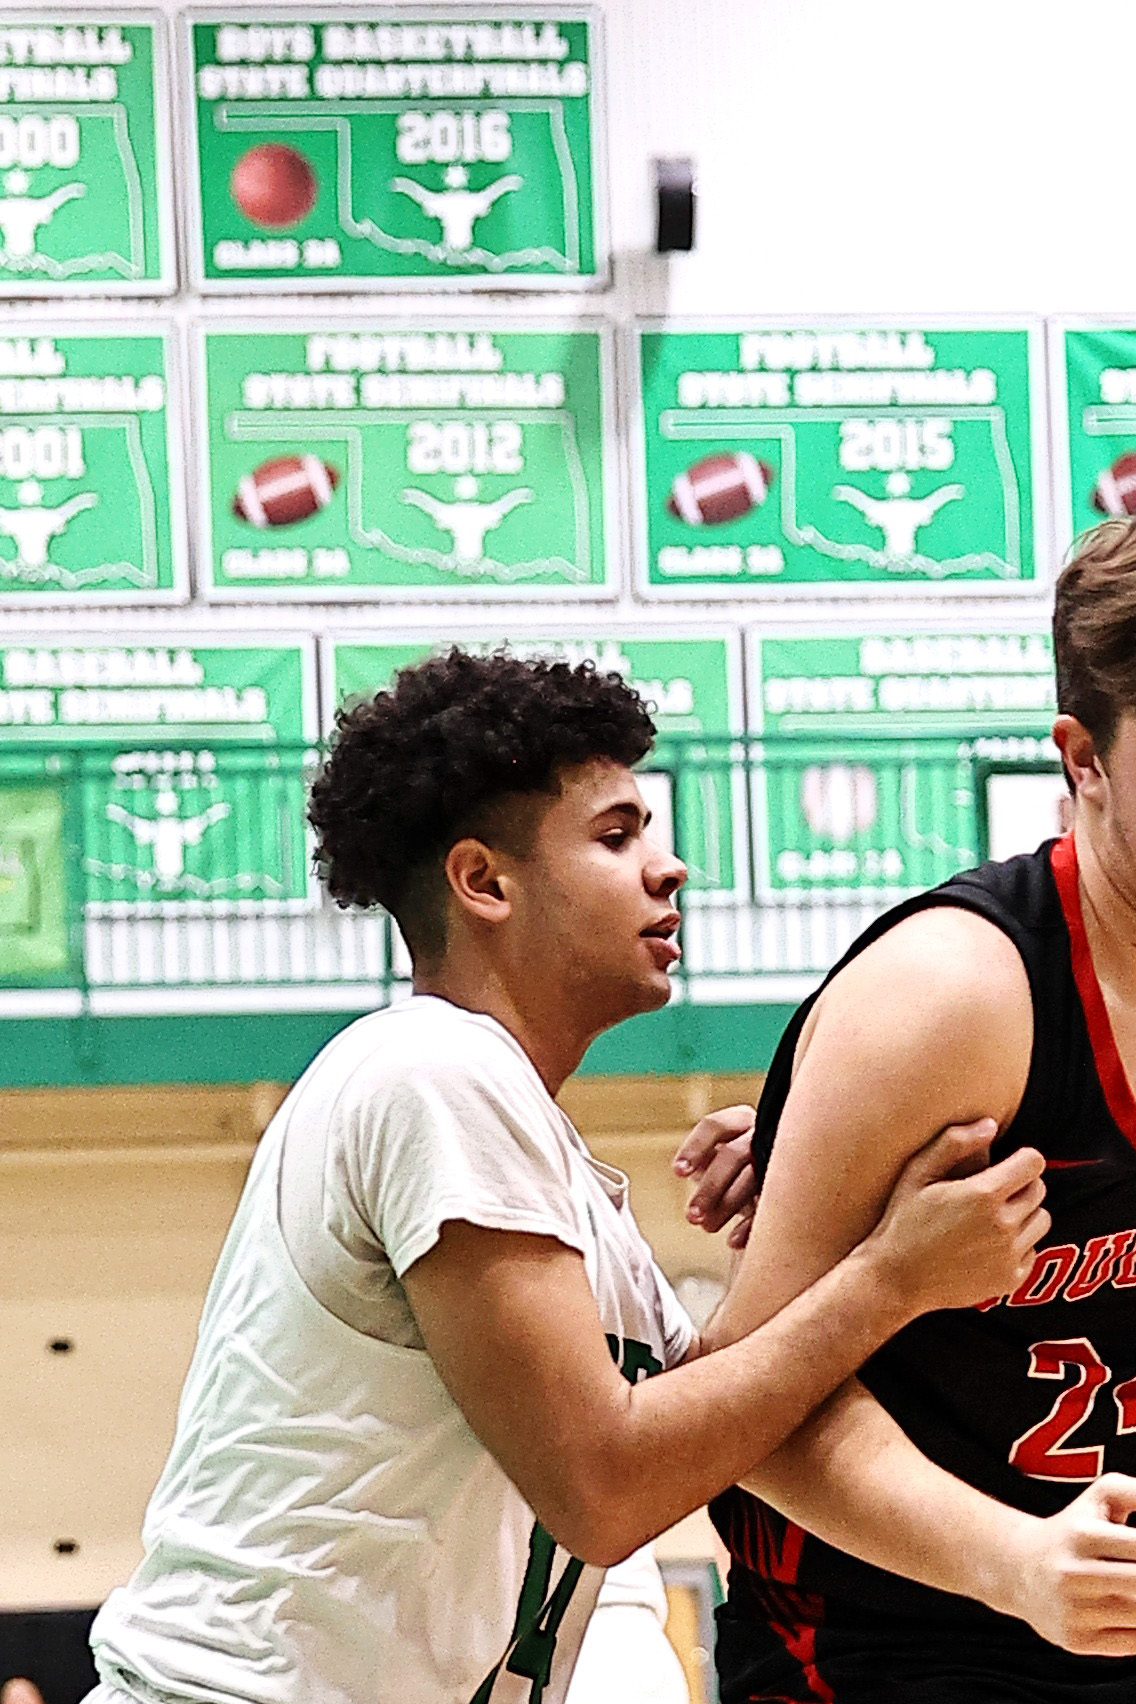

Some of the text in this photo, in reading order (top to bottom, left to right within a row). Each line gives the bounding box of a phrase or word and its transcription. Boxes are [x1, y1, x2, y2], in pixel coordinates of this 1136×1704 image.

[326, 26, 565, 58] BASKETBALL
[202, 68, 305, 96] STATE
[400, 114, 509, 160] 2016
[308, 333, 501, 370] FOOTBALL
[742, 331, 933, 368] FOOTBALL
[246, 375, 354, 407] STATE
[681, 373, 788, 406] STATE
[409, 421, 522, 472] 2012
[842, 418, 952, 469] 2015
